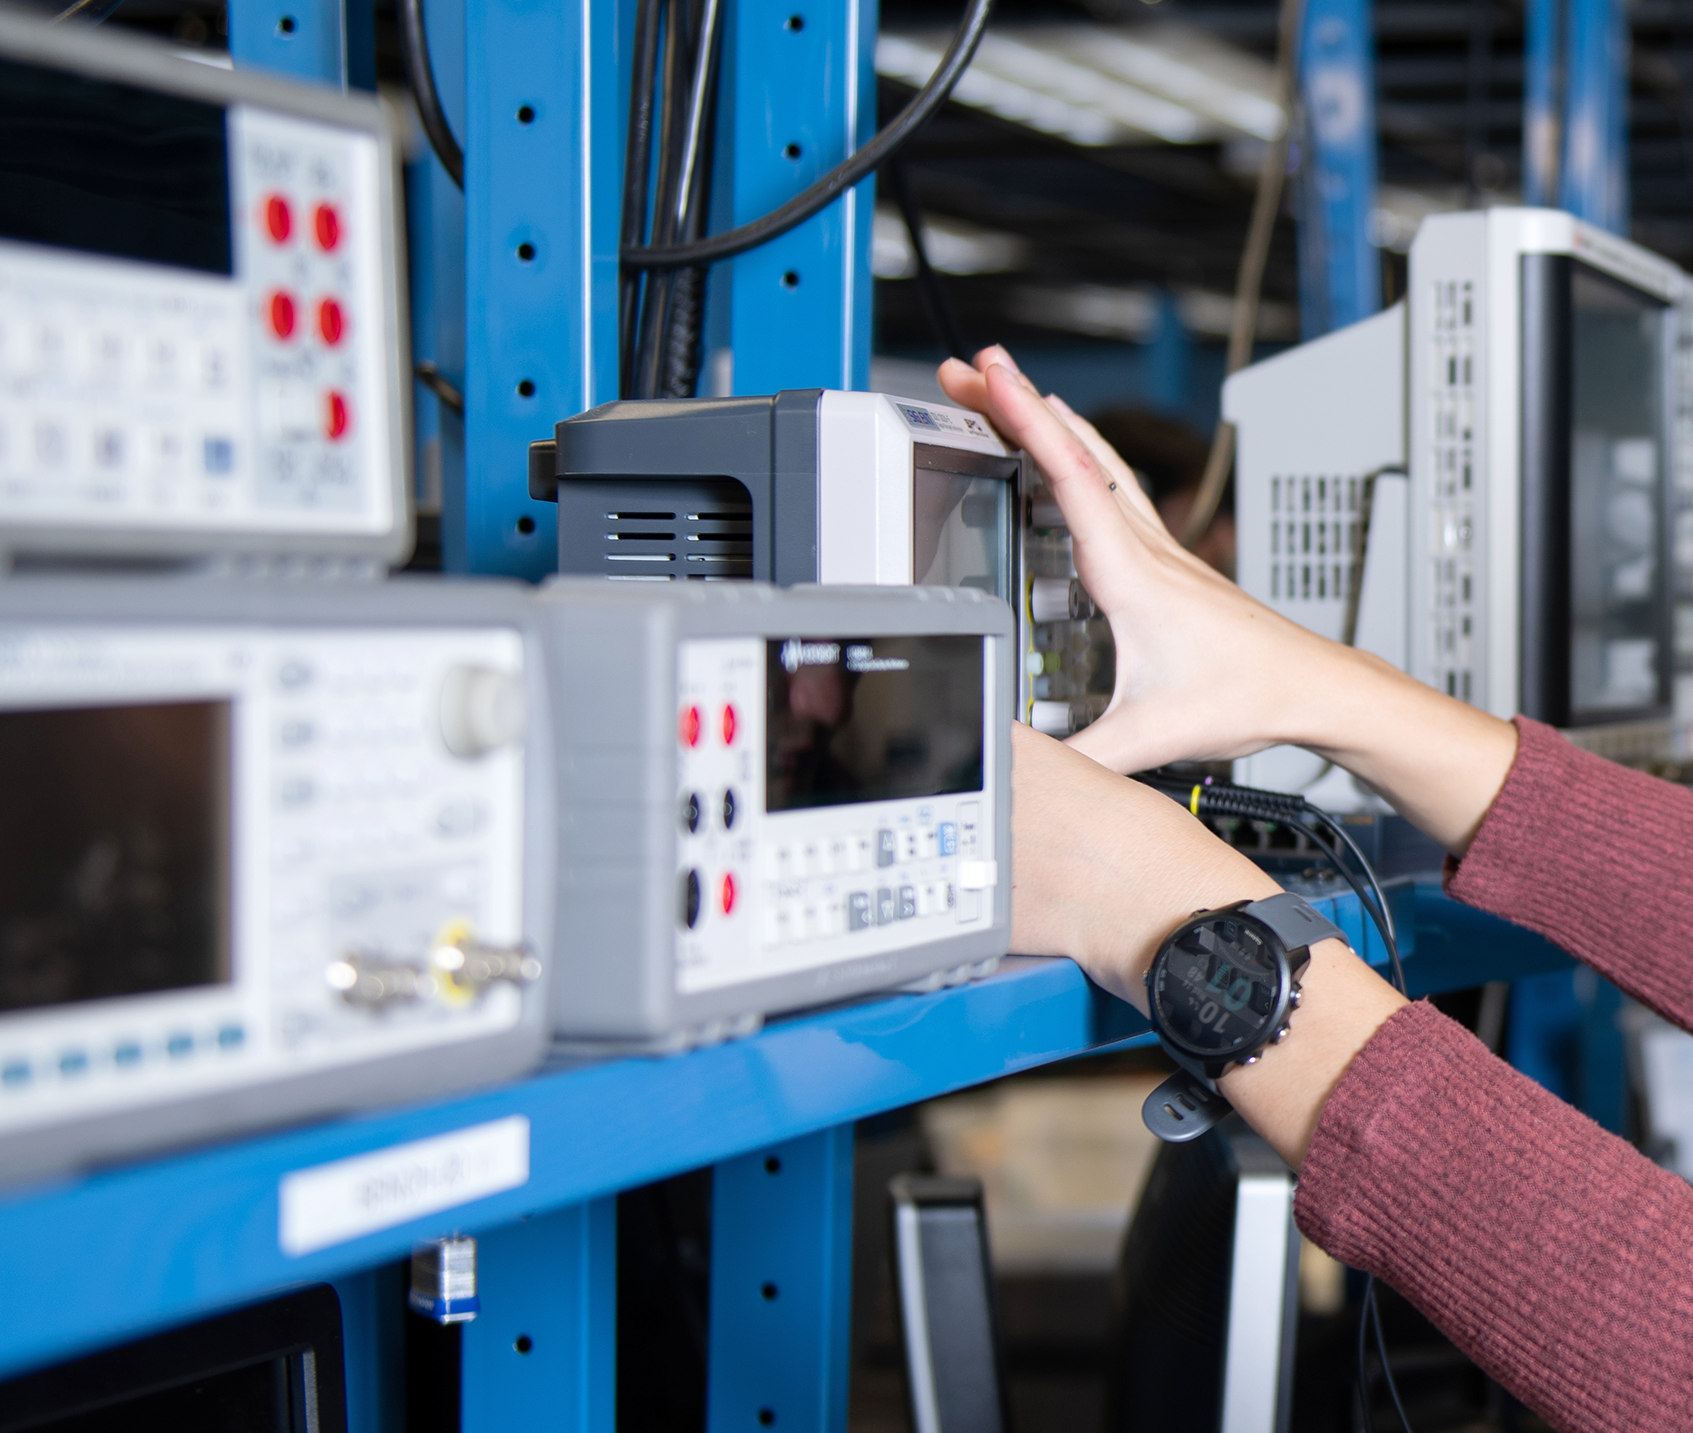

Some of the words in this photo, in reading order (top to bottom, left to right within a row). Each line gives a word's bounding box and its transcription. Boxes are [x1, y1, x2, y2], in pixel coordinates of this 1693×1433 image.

[1187, 966, 1204, 981] 48
[1205, 963, 1252, 1011] 01
[1198, 1001, 1230, 1034] 10
